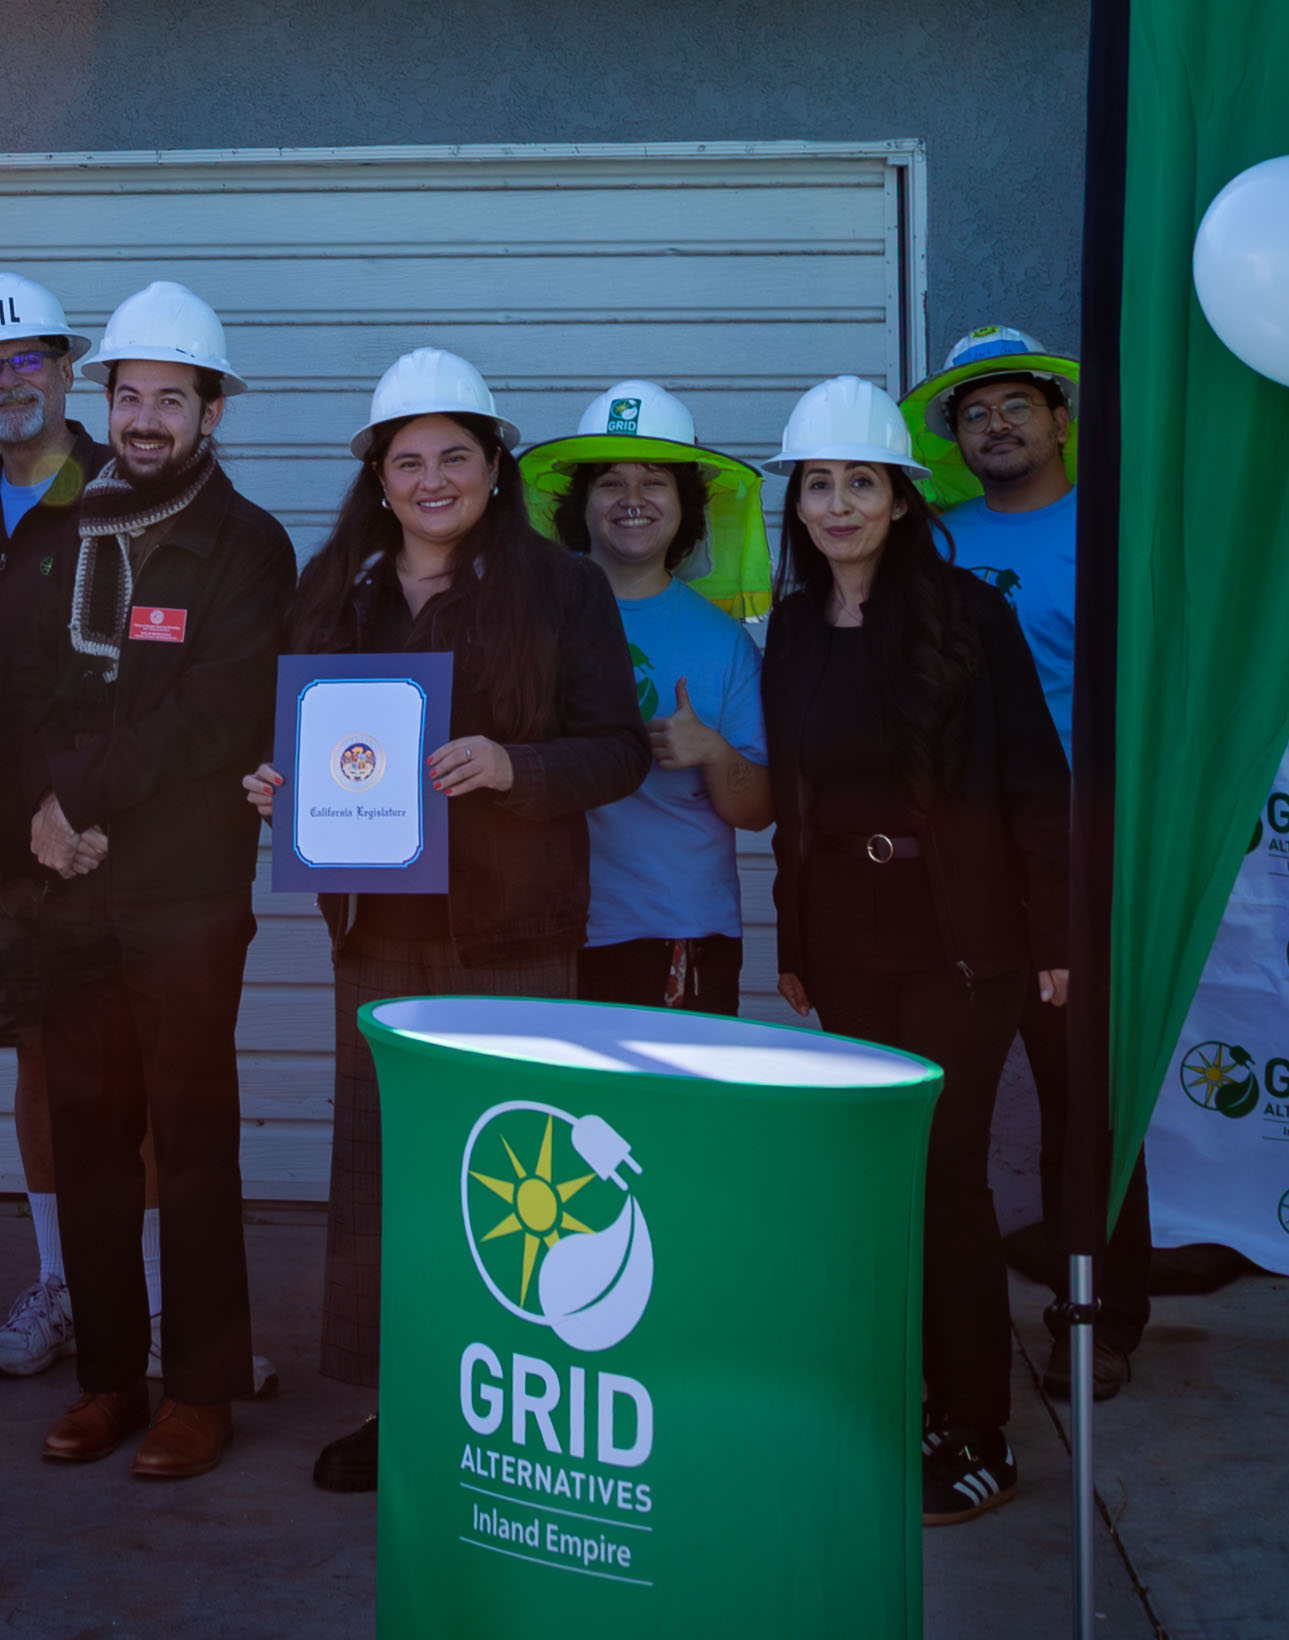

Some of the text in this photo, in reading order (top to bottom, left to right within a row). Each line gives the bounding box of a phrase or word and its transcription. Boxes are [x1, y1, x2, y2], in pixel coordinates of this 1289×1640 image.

[608, 420, 637, 431] GRID
[461, 1342, 654, 1467] GRID
[461, 1443, 653, 1513] ALTERNATIVES
[473, 1503, 631, 1567] Inland Empire
